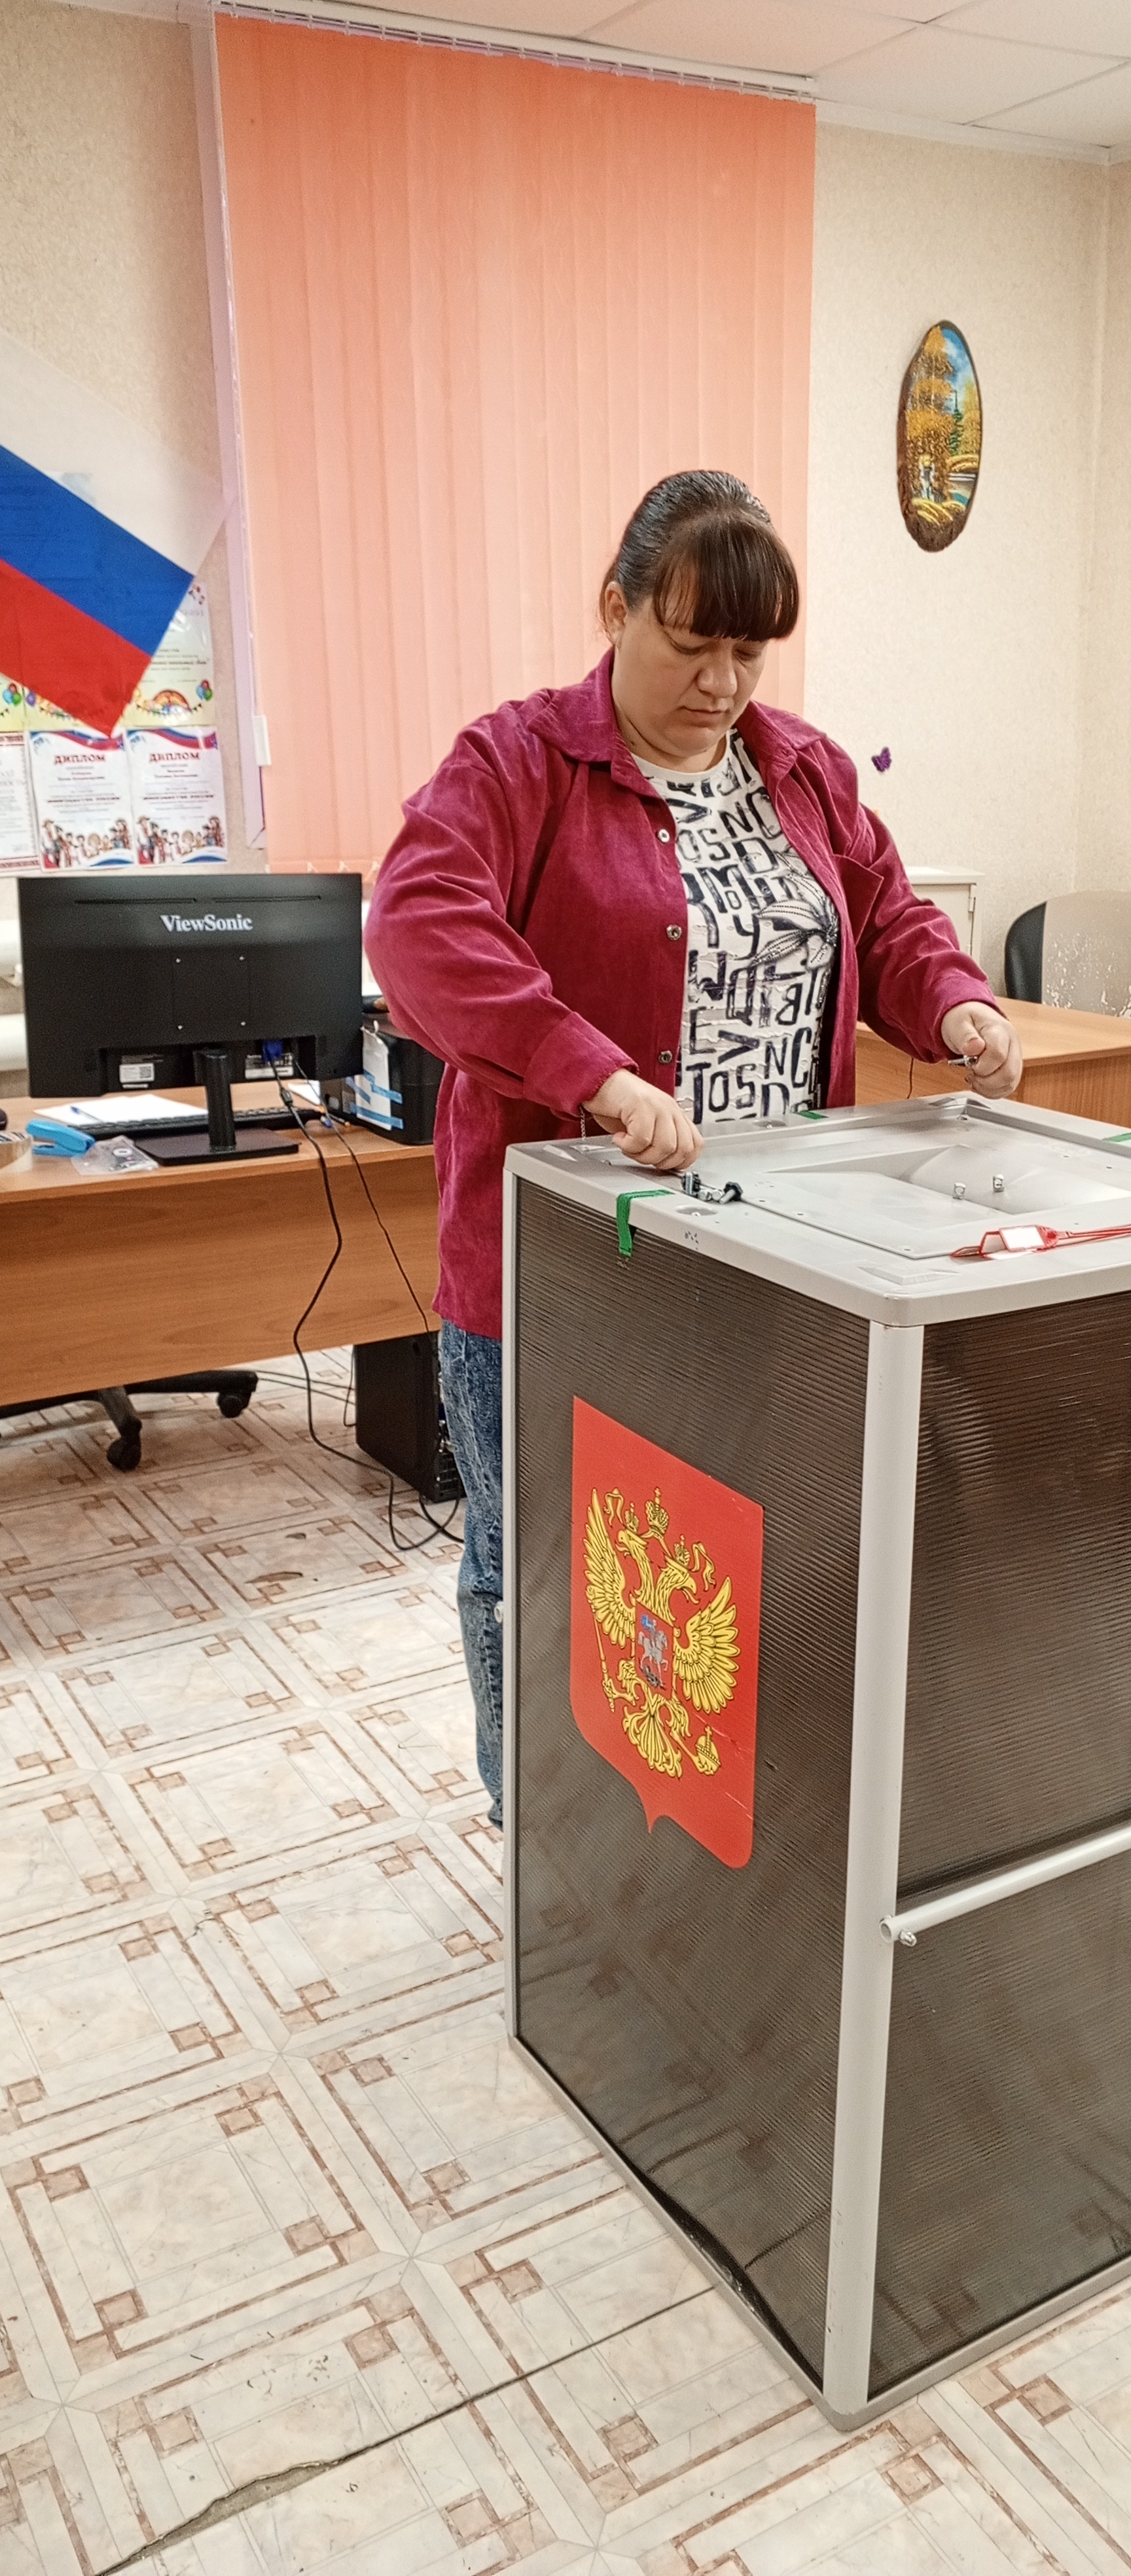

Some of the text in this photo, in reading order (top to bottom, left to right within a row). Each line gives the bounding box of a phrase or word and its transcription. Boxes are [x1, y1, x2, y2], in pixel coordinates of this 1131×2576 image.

[54, 754, 105, 764] ДИПЛОМ
[149, 752, 200, 763] ДИПЛОМ
[160, 914, 253, 932] ViewSonic
